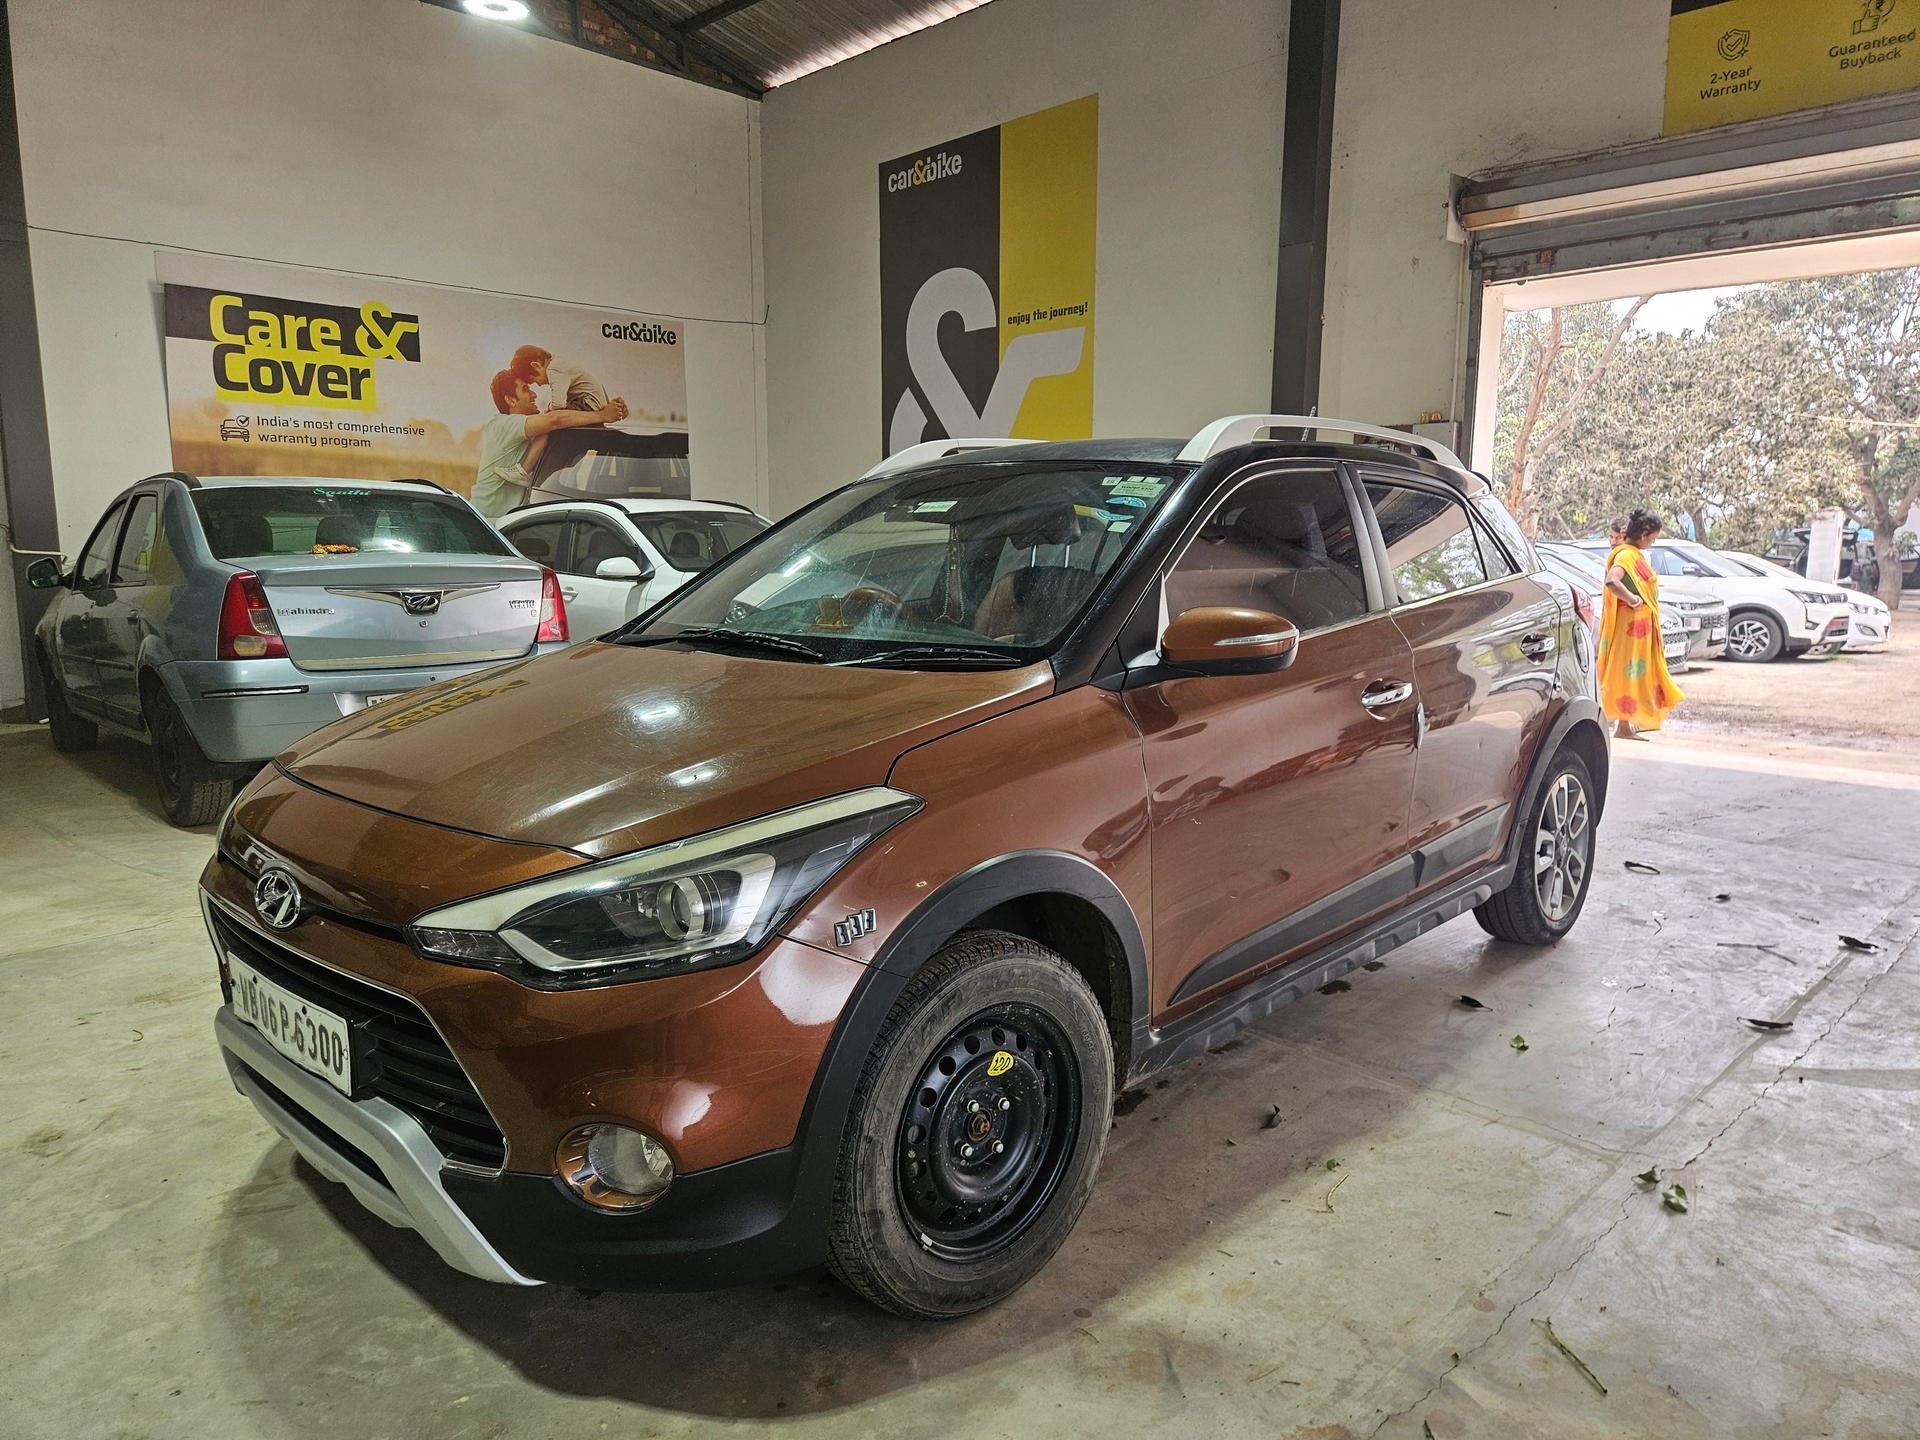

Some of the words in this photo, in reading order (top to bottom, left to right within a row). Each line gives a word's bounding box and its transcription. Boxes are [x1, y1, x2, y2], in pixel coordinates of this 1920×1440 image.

[1828, 29, 1916, 58] Guaranteed
[1840, 48, 1902, 70] Buyback
[1710, 66, 1752, 85] 2-Year
[1700, 80, 1761, 99] Warranty
[888, 152, 963, 193] car&bike
[1007, 312, 1031, 326] enjoy
[1033, 309, 1048, 320] the
[1049, 301, 1088, 320] journey!
[209, 294, 342, 354] Care
[355, 301, 419, 361] &
[601, 322, 677, 345] car&bike
[213, 343, 371, 400] Cover
[256, 415, 300, 428] India's
[303, 419, 334, 430] most
[337, 422, 425, 436] comprehensive
[258, 432, 317, 447] warranty
[320, 434, 371, 448] program
